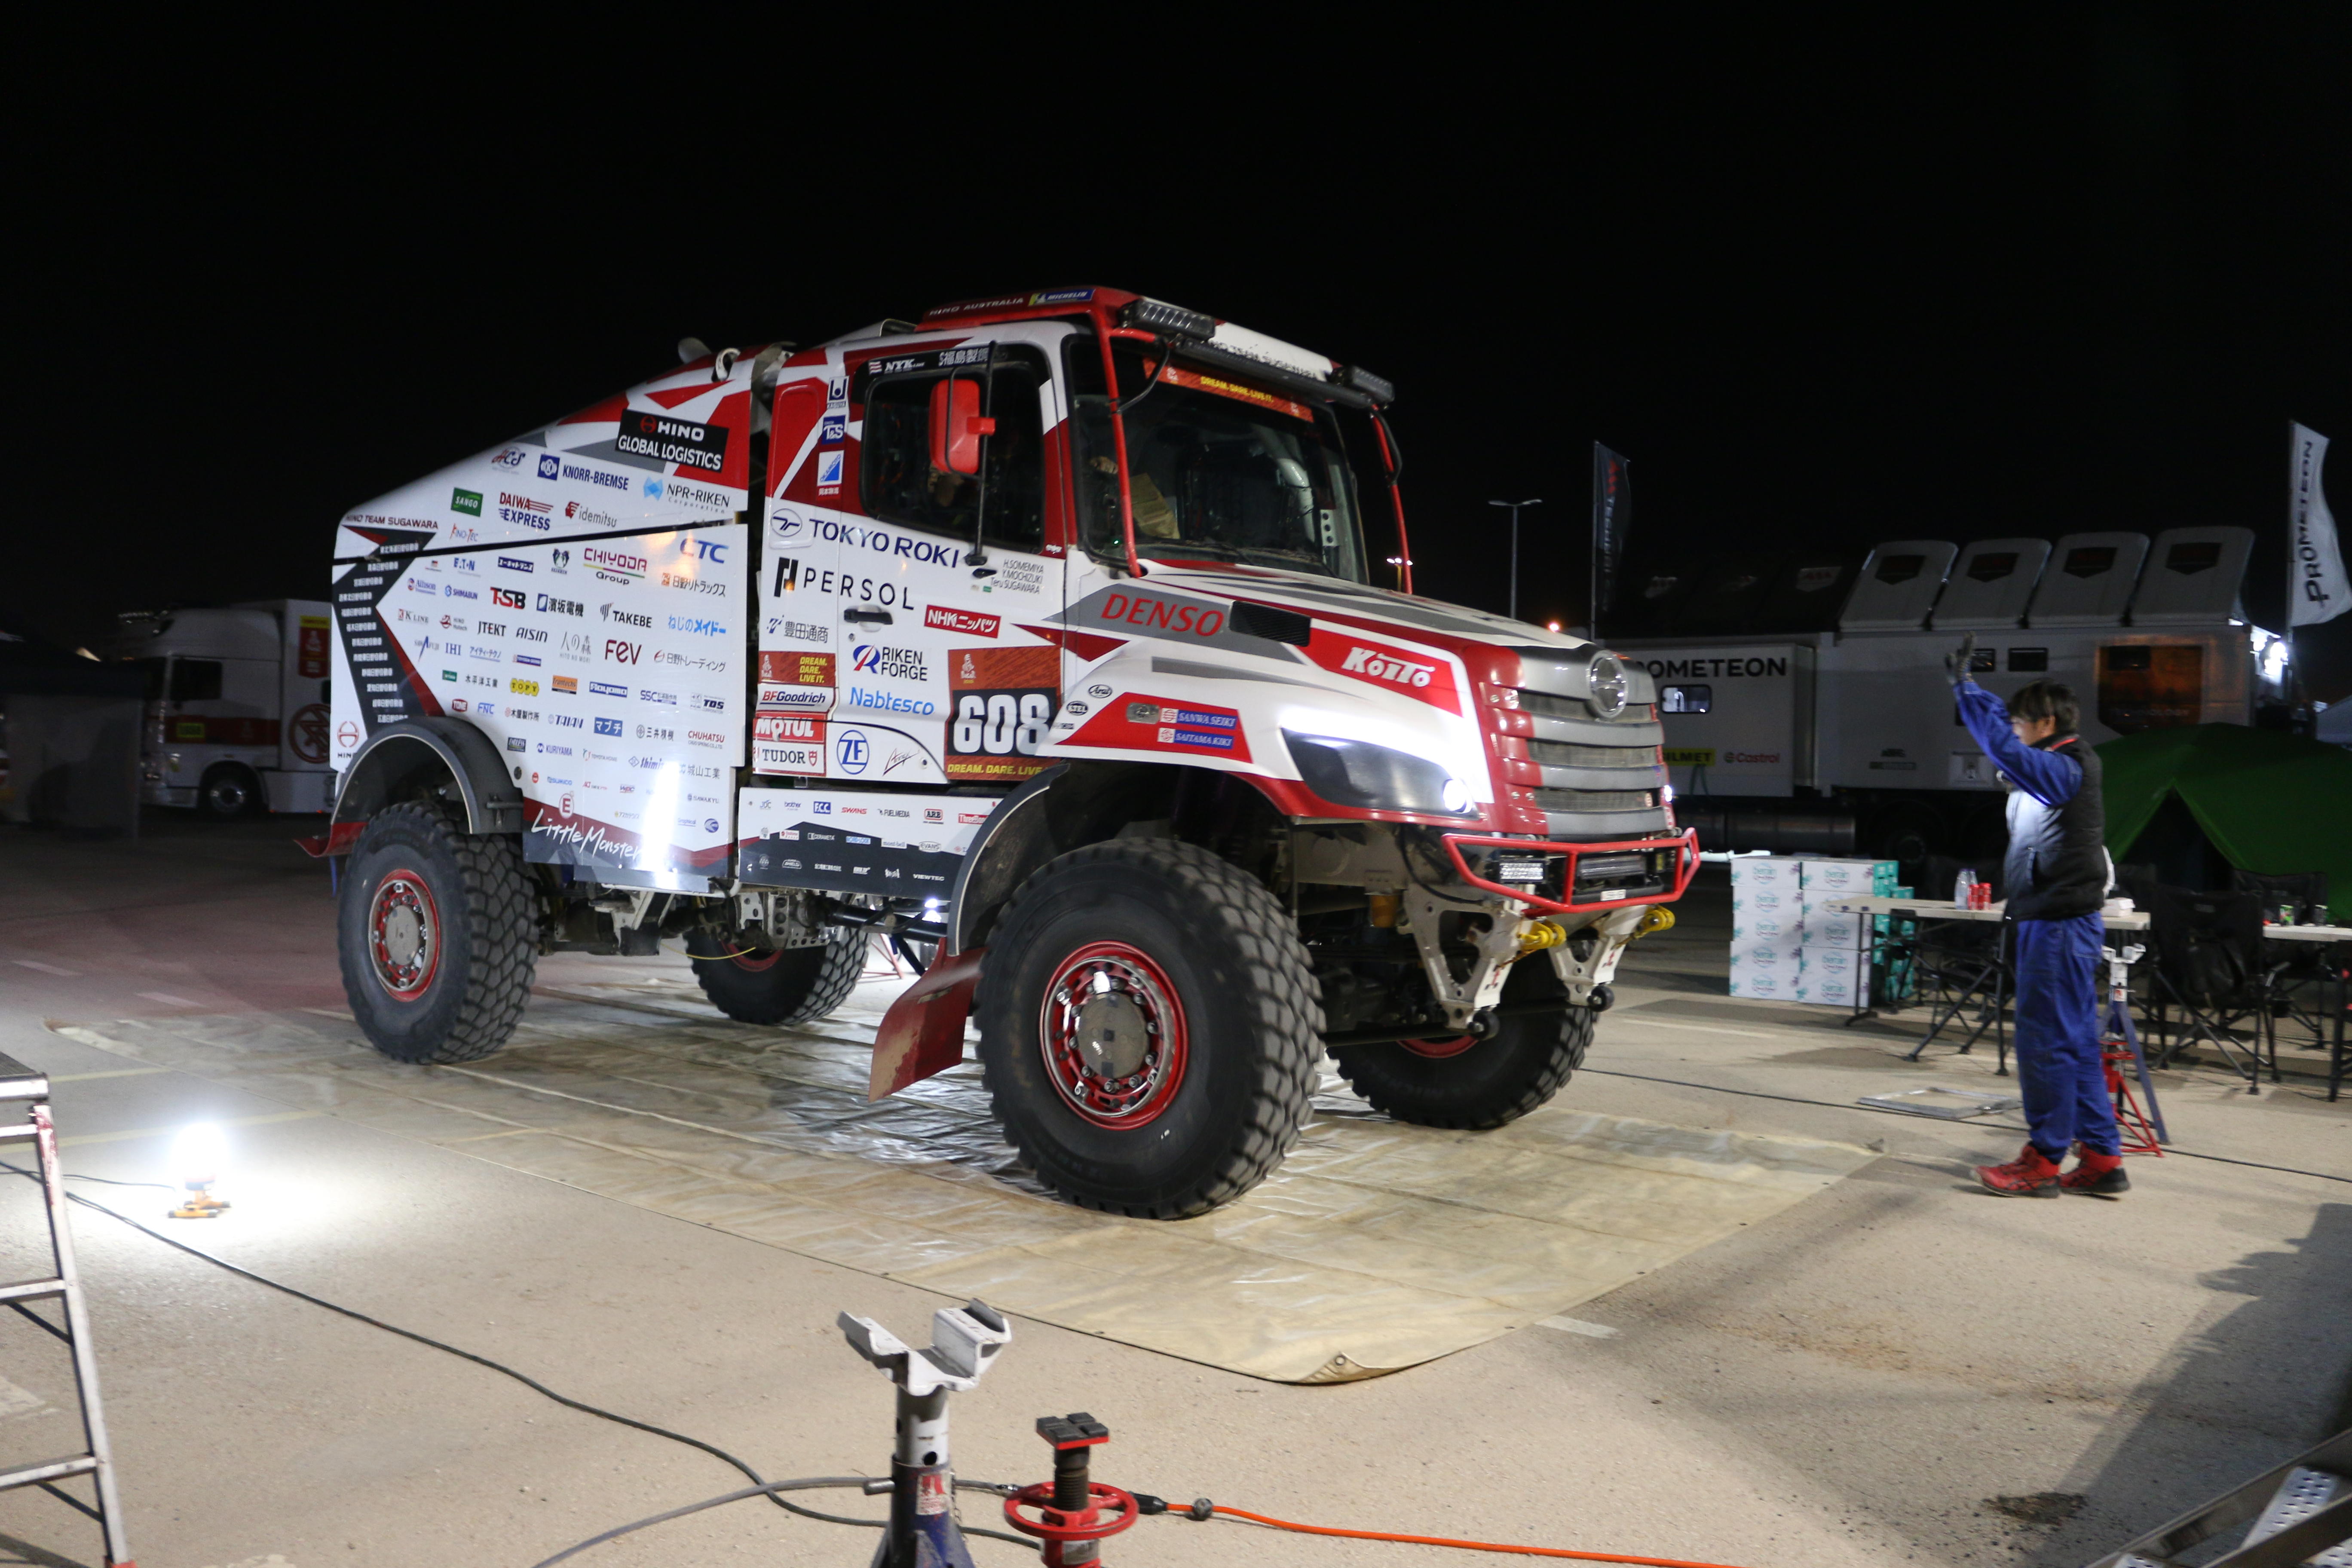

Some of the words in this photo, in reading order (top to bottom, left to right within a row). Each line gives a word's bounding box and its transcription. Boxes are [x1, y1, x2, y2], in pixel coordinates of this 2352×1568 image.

[1047, 291, 1088, 300] MICHELIN
[963, 297, 1024, 311] AUSTRALIA
[884, 358, 915, 371] NYK
[657, 421, 705, 442] HINO
[823, 424, 843, 440] T&S
[618, 435, 659, 457] GLOBAL
[661, 442, 722, 471] LOGISTICS
[563, 464, 629, 490] KNORR-BREMSE
[455, 496, 479, 509] SANGO
[499, 492, 530, 511] DAIWA
[667, 483, 730, 508] NPR-RIKEN
[364, 515, 386, 525] TEAM
[387, 517, 438, 530] SUGAWARA
[503, 508, 551, 531] EXPRESS
[579, 506, 617, 528] idemitsu
[680, 538, 729, 564] CTC
[809, 518, 890, 552] TOKYO
[894, 536, 960, 568] ROKI
[583, 547, 648, 572] CHIYODA
[416, 579, 436, 591] Allison
[595, 570, 630, 586] Group
[1003, 578, 1040, 594] SUGAWARA
[803, 567, 914, 611] PERSOL
[490, 586, 526, 610] TSB
[612, 610, 652, 628] TAKEBE
[927, 609, 997, 633] NHKニッパツ
[1101, 593, 1225, 637] DENSO
[477, 621, 507, 637] JTEKT
[668, 614, 726, 637] ねじのメイドー
[515, 627, 548, 643] AISIN
[445, 643, 462, 655] IHI
[882, 646, 923, 665] RIKEN
[666, 652, 727, 673] 日野トレーディング
[799, 656, 827, 666] DREAM.
[1636, 658, 1786, 679] OMETEON
[799, 674, 815, 683] LIVE
[881, 662, 928, 681] FORGE
[511, 681, 539, 694] TOPY
[640, 689, 658, 702] SSC
[762, 690, 826, 704] BFGoodrich
[849, 686, 934, 716] Nabtesco
[555, 714, 584, 729] TAIAN
[595, 720, 622, 735] マブチ
[754, 716, 814, 738] MOTUL
[953, 693, 1050, 755] 608
[688, 730, 725, 743] CHUHATSU
[545, 744, 573, 756] KURIYAMA
[762, 748, 806, 764] TUDOR
[839, 739, 867, 766] ZF
[1736, 752, 1781, 764] Castrol
[947, 763, 984, 773] DREAM.
[986, 764, 1017, 775] DARE.
[562, 798, 571, 813] E
[926, 810, 941, 819] ARB
[913, 873, 945, 882] VIEWTEC
